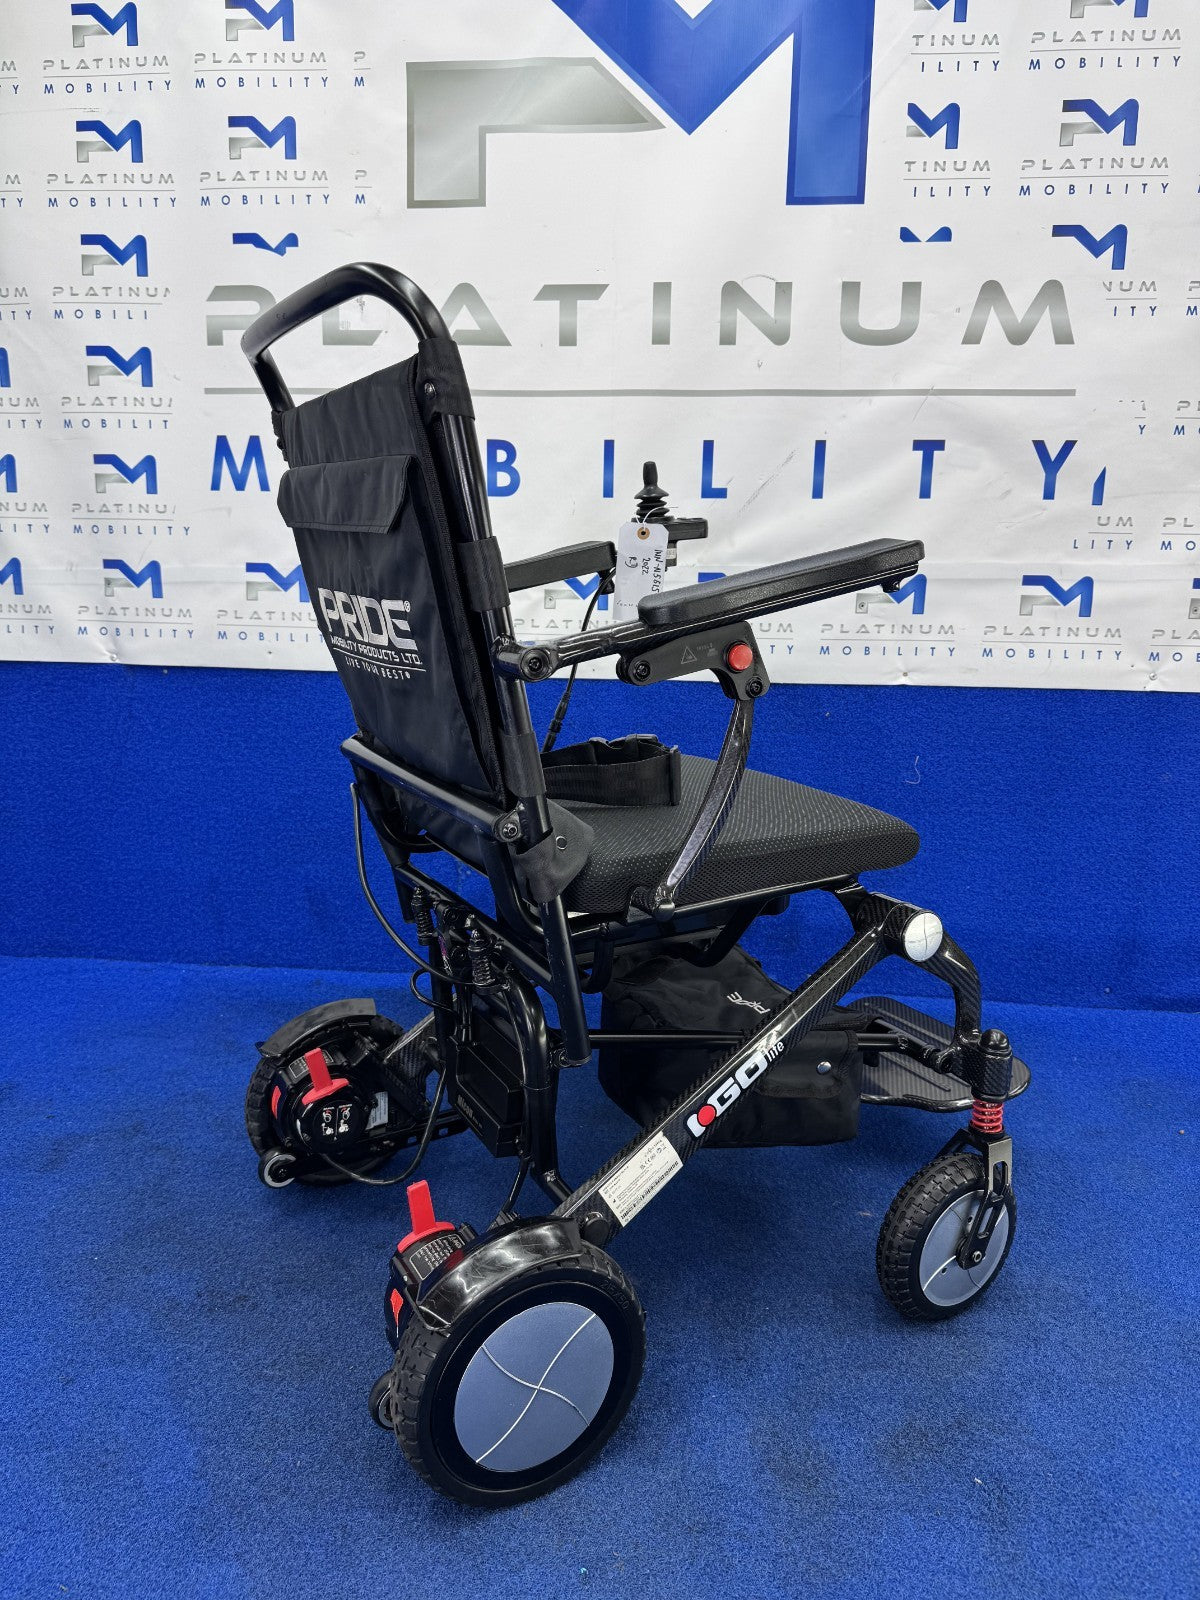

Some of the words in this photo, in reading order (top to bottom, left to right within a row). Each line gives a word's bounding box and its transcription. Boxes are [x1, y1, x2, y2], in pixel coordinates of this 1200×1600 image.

[1031, 29, 1180, 43] PLATINUM
[43, 56, 169, 70] PLATINUM
[195, 52, 326, 64] PLATINUM
[1029, 56, 1181, 70] MOBILITY
[44, 77, 171, 94] MOBILITY
[195, 77, 328, 88] MOBILITY
[1022, 157, 1168, 170] PLATINUM
[47, 174, 174, 184] PLATINUM
[200, 171, 328, 182] PLATINUM
[1019, 183, 1169, 196] MOBILITY
[48, 197, 176, 207] MOBILITY
[201, 194, 329, 206] MOBILITY
[205, 280, 1074, 346] PLATINUM
[62, 397, 172, 407] PLATINU
[211, 436, 1078, 500] MBILITY
[73, 525, 190, 535] MOBILITY
[79, 606, 192, 617] PLATINUM
[78, 627, 193, 639] MOBILITY
[821, 624, 954, 634] PLATINUM
[984, 626, 1121, 638] PLATINUM
[218, 629, 326, 644] MOBILIT
[330, 634, 358, 653] MOBILITY
[358, 643, 400, 662] PRODUCTS
[819, 646, 955, 656] MOBILITY
[982, 647, 1121, 661] MOBILITY
[345, 655, 361, 669] LIVE
[361, 661, 380, 675] YOUR
